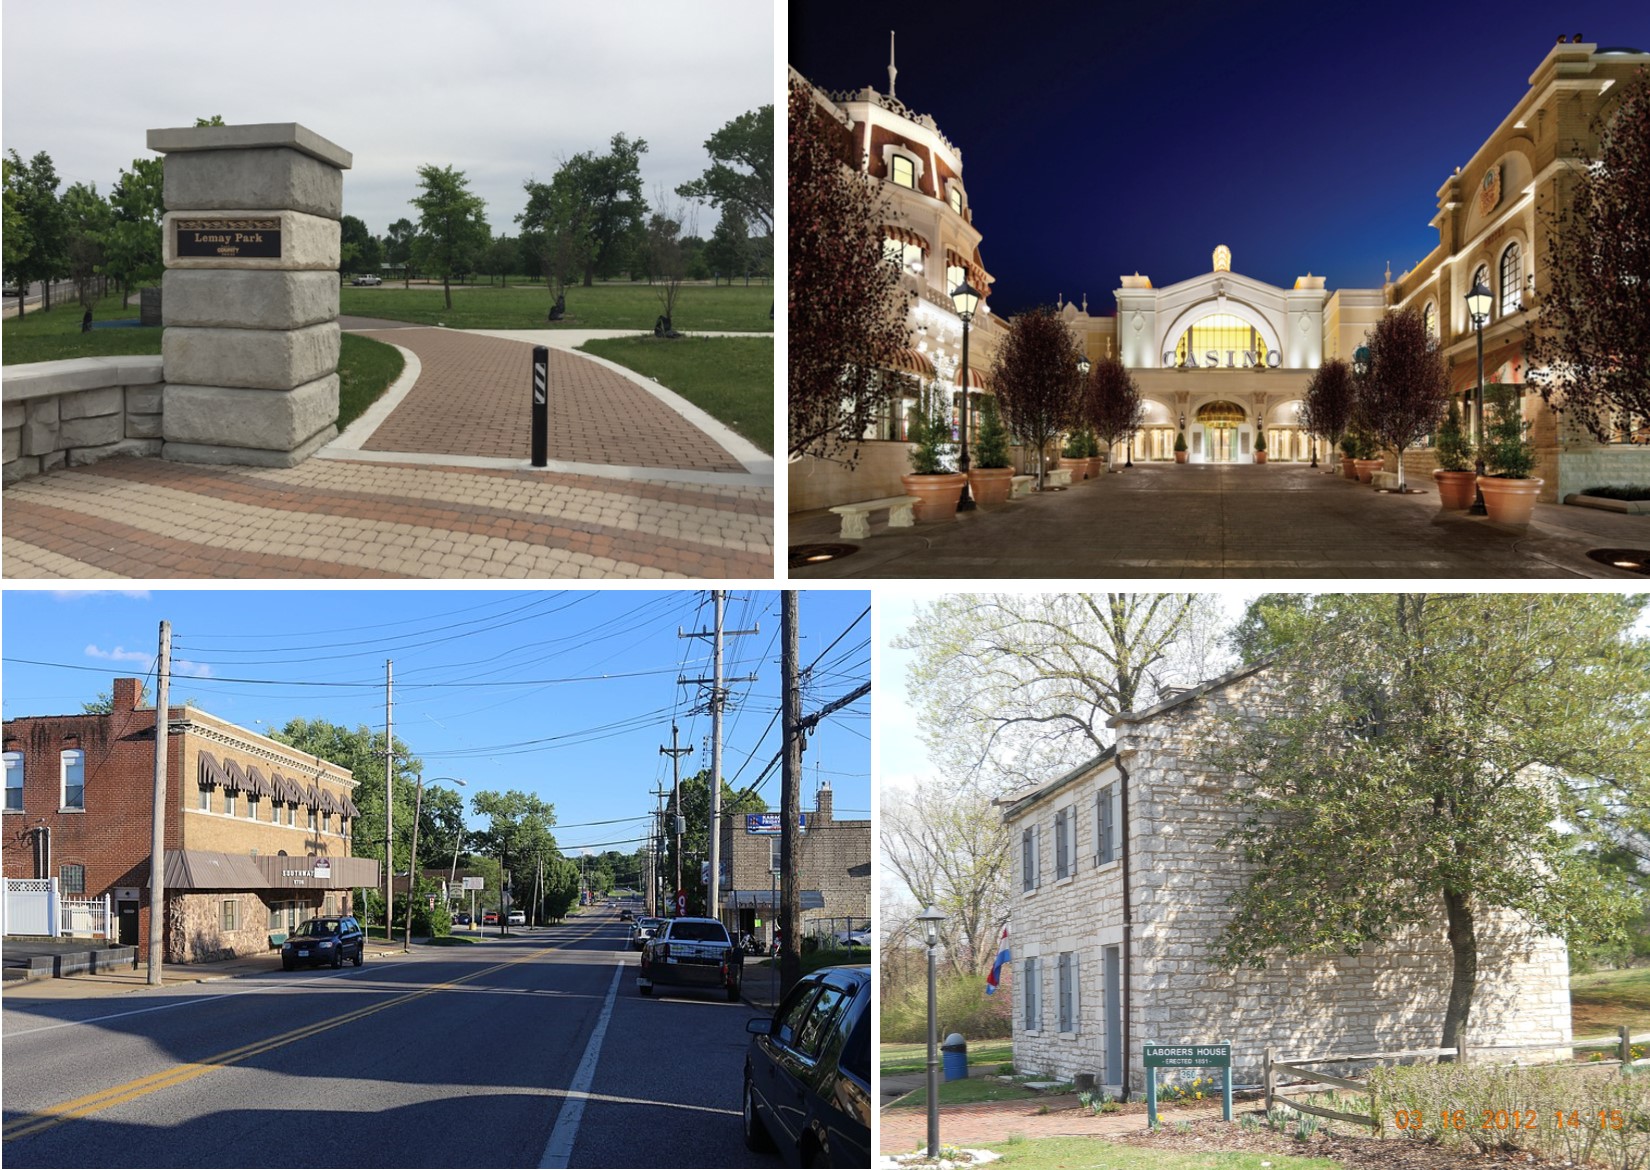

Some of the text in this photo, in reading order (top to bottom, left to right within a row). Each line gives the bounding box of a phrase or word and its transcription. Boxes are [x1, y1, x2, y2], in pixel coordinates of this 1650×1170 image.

[195, 233, 262, 244] Lemay Park
[1163, 350, 1282, 368] CASINO
[1147, 1048, 1227, 1056] LABORERS HOUSE
[1181, 1070, 1196, 1079] 360
